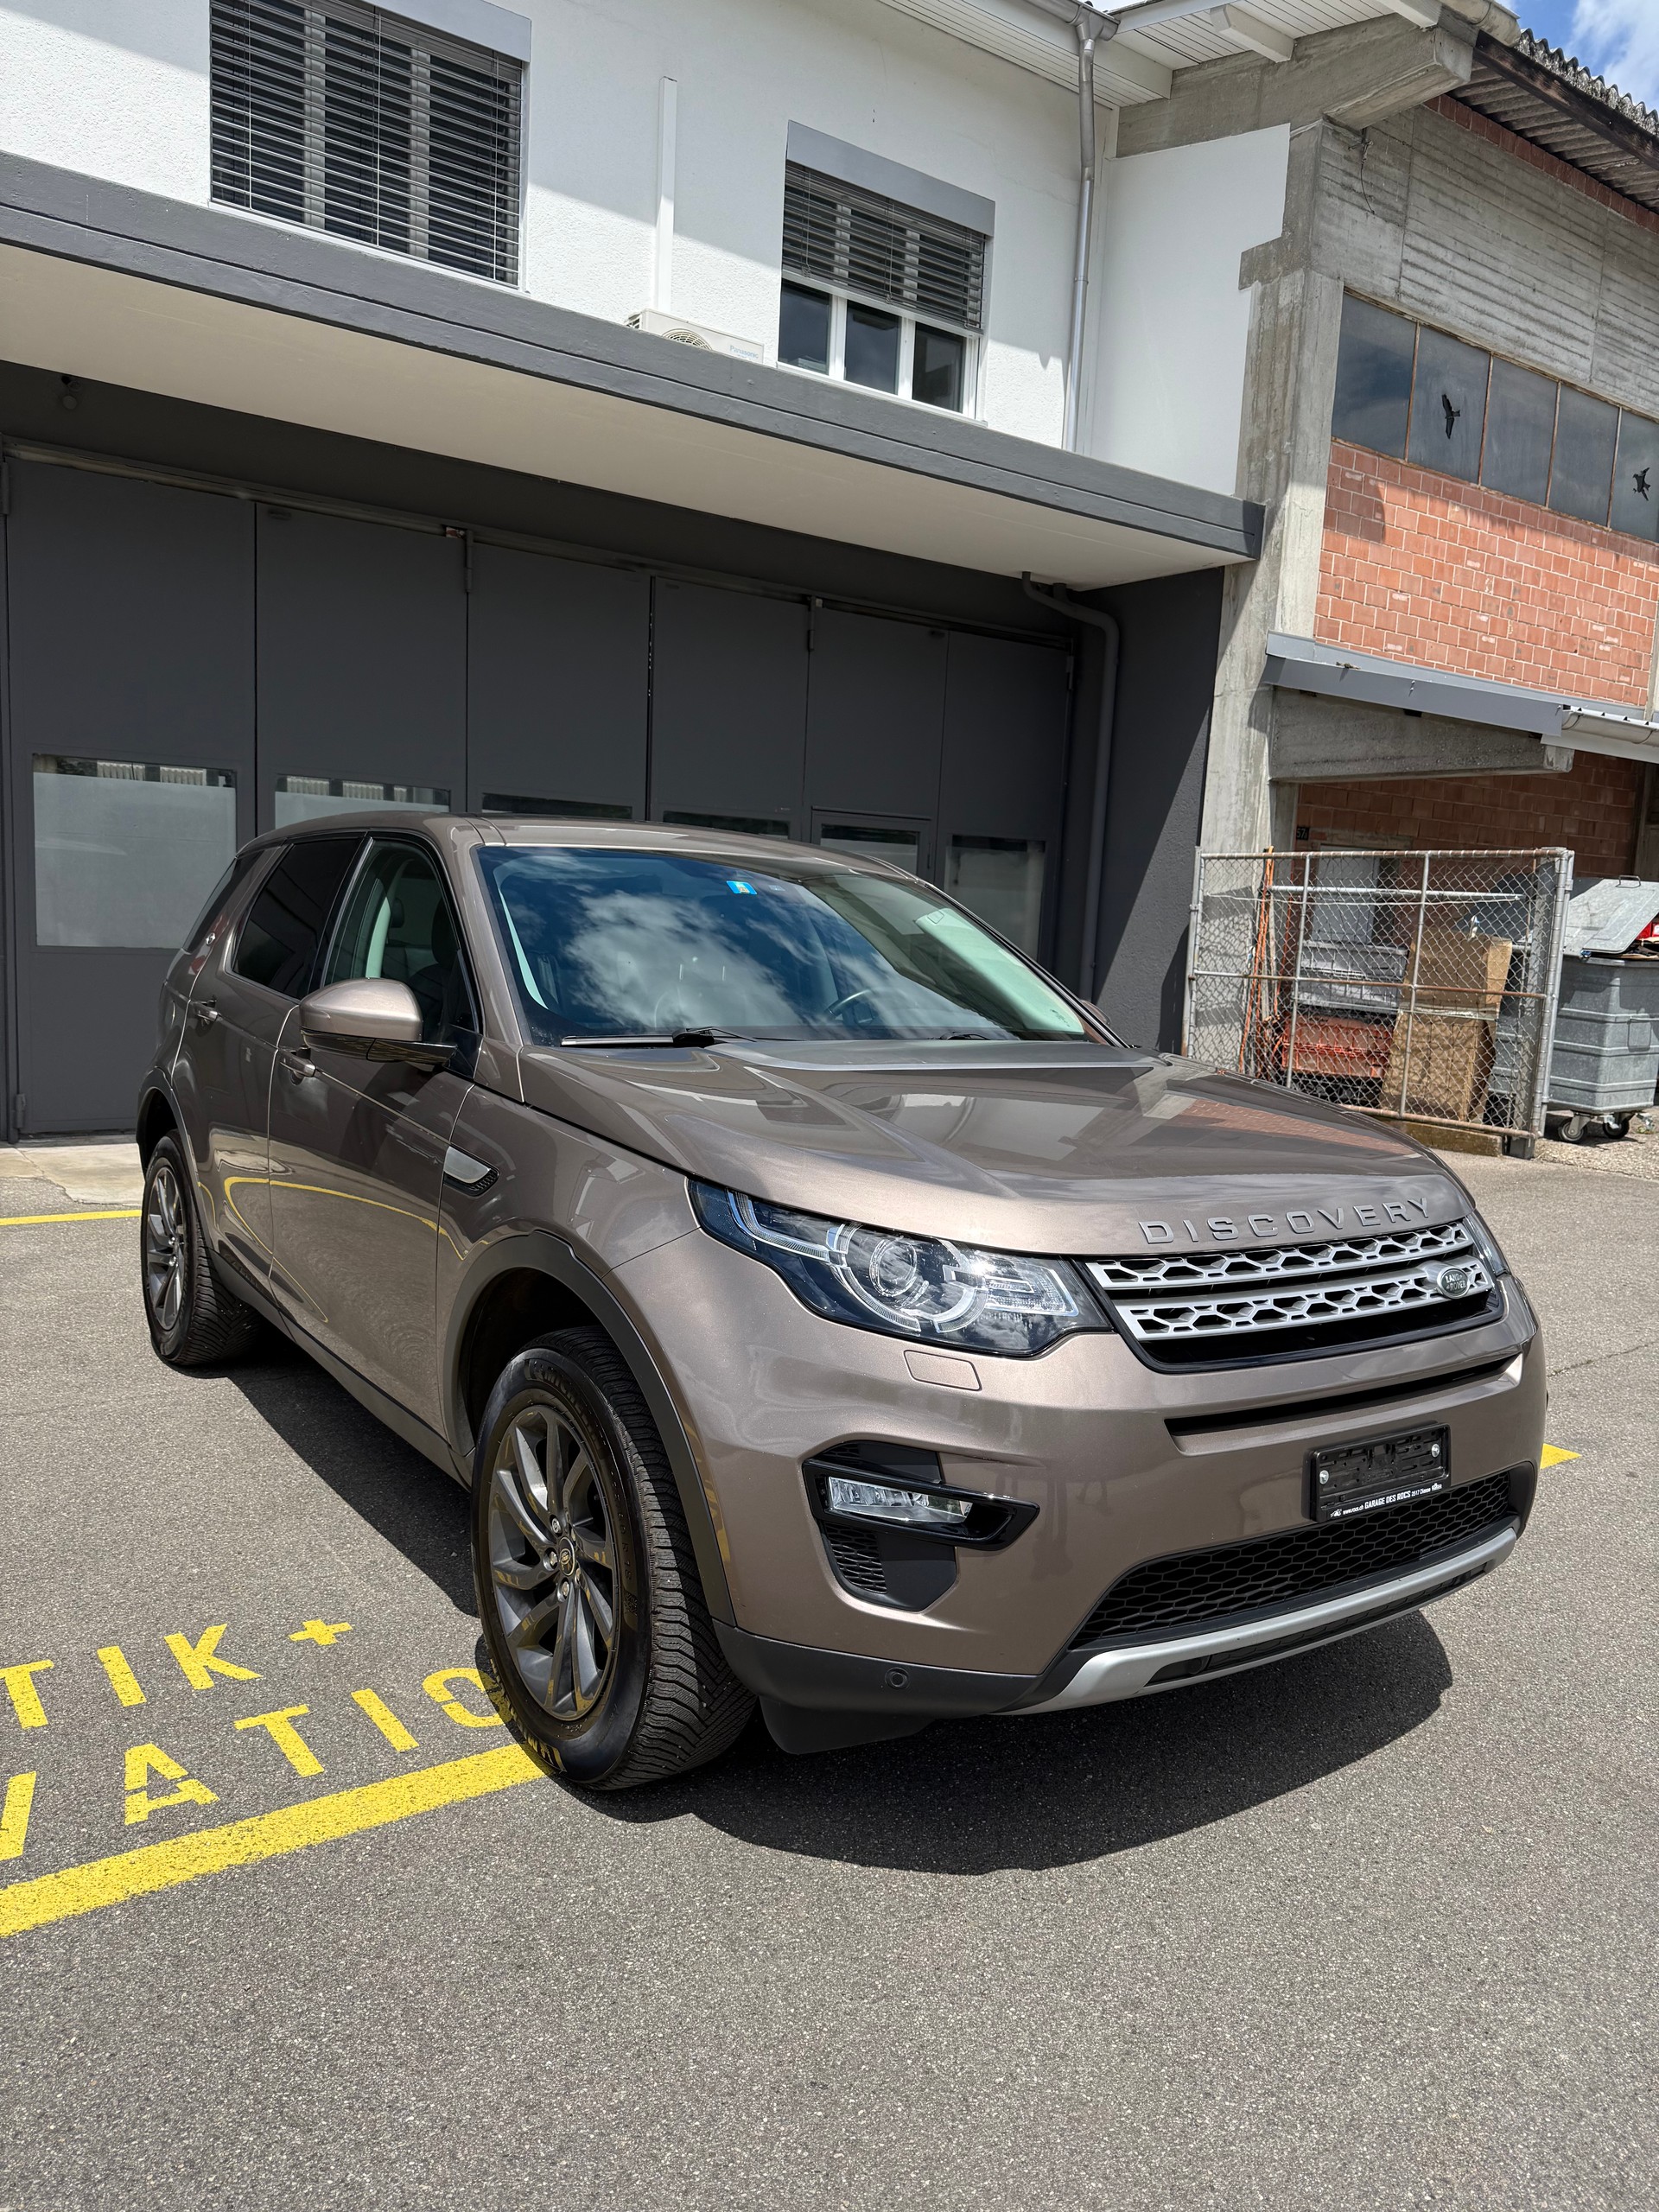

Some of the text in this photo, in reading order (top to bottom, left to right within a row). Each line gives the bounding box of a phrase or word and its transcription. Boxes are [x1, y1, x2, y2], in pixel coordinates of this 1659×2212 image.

[730, 345, 759, 359] Panasonic
[1138, 1197, 1431, 1245] DISCOVERY
[1445, 1274, 1460, 1283] LAND
[1450, 1280, 1466, 1291] ROVER
[1364, 1497, 1385, 1509] GARAGE
[1386, 1495, 1396, 1503] DES
[1397, 1491, 1411, 1501] ROCS
[0, 1623, 264, 1730] TIK
